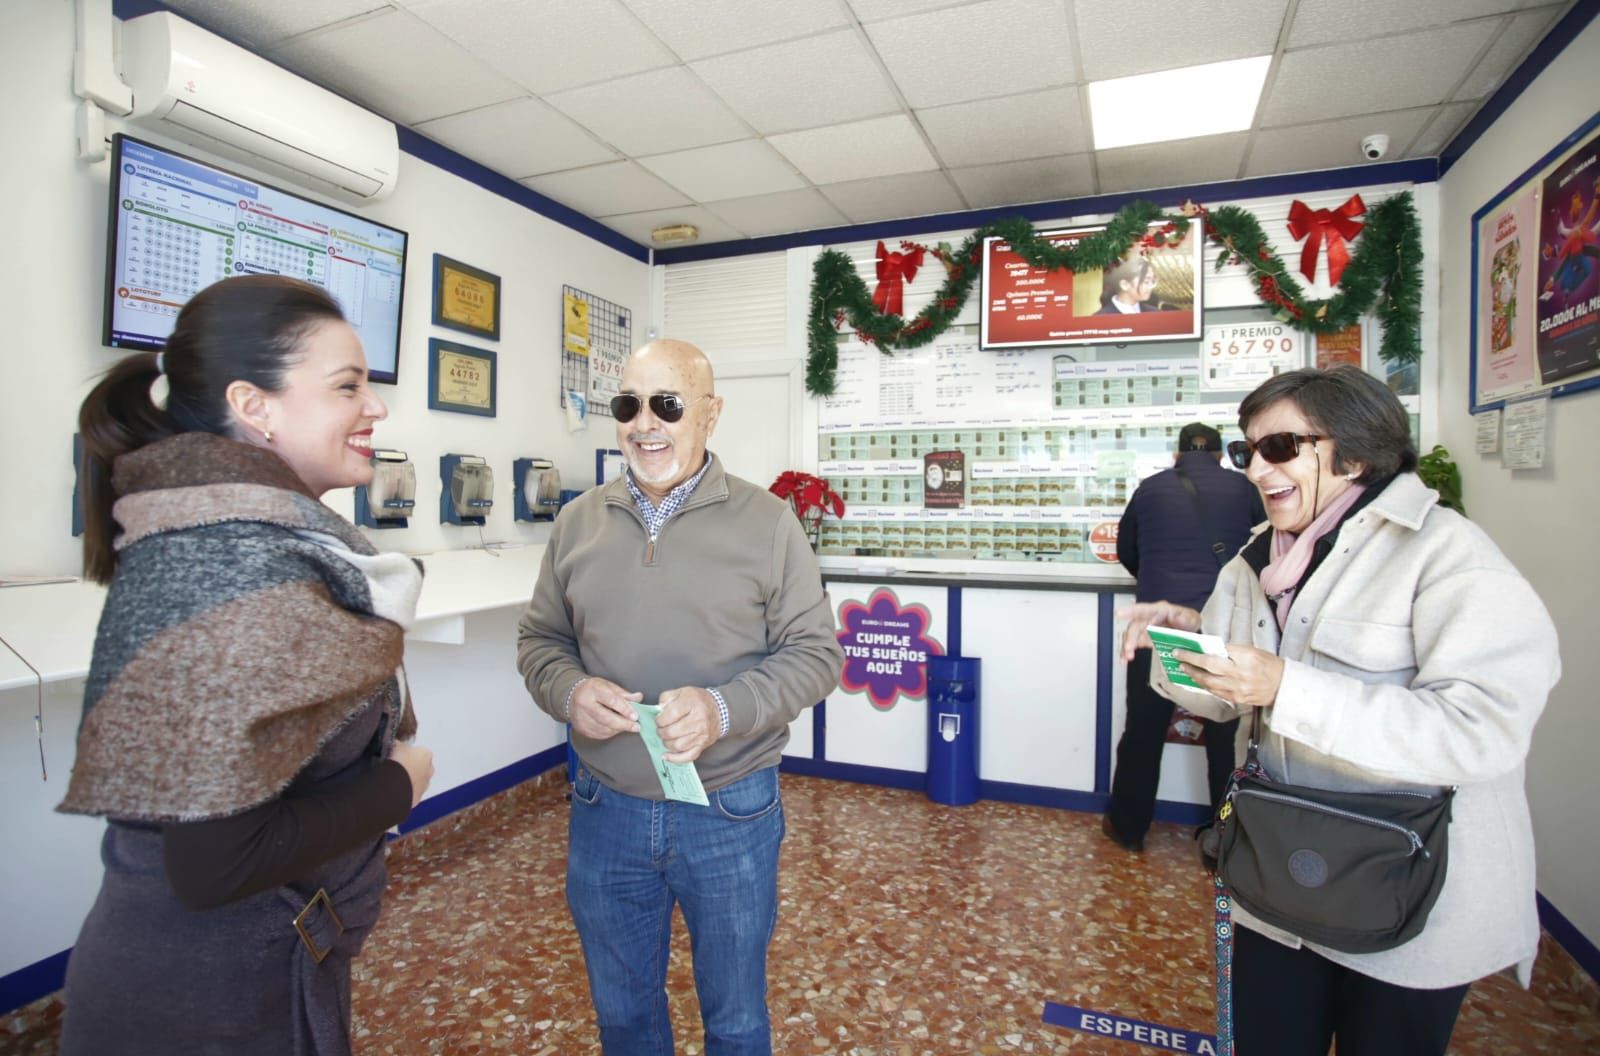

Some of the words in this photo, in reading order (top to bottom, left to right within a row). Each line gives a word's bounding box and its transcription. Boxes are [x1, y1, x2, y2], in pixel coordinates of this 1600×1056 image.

[1540, 306, 1575, 333] 20.000€
[1231, 326, 1283, 338] PREMIO
[1211, 338, 1293, 356] 56790
[601, 350, 622, 363] PREMIO
[450, 368, 480, 381] 44782
[856, 632, 911, 647] CUMPLE
[844, 645, 869, 658] TUS
[872, 646, 926, 663] SUEÑOS
[866, 661, 902, 675] AQUÍ
[1080, 1013, 1187, 1050] ESPERE
